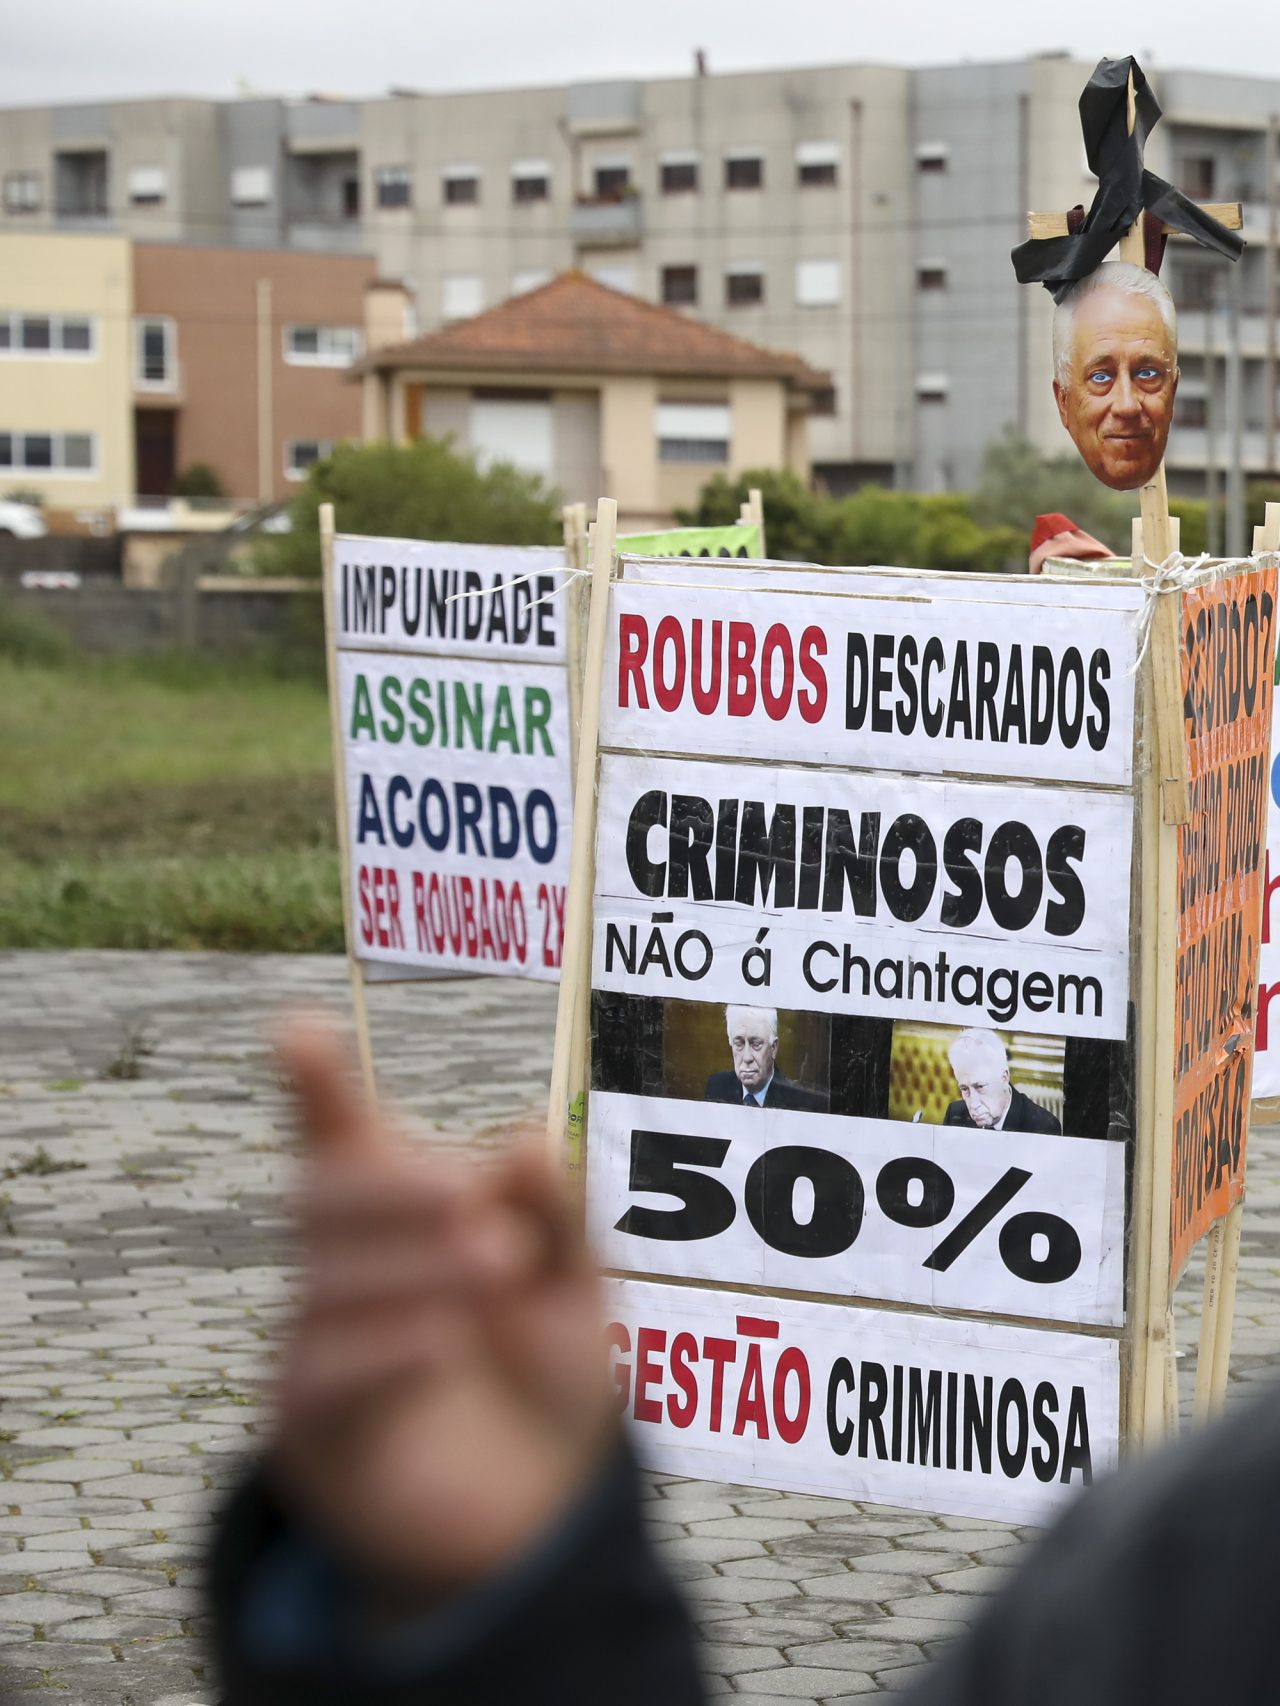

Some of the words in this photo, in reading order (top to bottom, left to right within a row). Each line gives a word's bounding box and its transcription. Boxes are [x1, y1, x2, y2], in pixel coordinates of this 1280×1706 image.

[342, 564, 556, 647] IMPUNIDADE
[351, 674, 555, 757] ASSINAR
[618, 613, 828, 724] ROUBOS
[845, 632, 1111, 752] DESCARADOS
[357, 774, 558, 864] ACORDO
[625, 790, 1086, 937] CRIMINOSOS
[1225, 751, 1264, 882] ROUBO
[359, 865, 404, 949] SER
[412, 871, 527, 967] ROUBADO
[604, 911, 713, 981] NÃO
[802, 940, 1103, 1023] Chantagem
[612, 1129, 1082, 1284] 50%
[604, 1315, 811, 1444] GESTÃO
[826, 1356, 1093, 1486] CRIMINOSA
